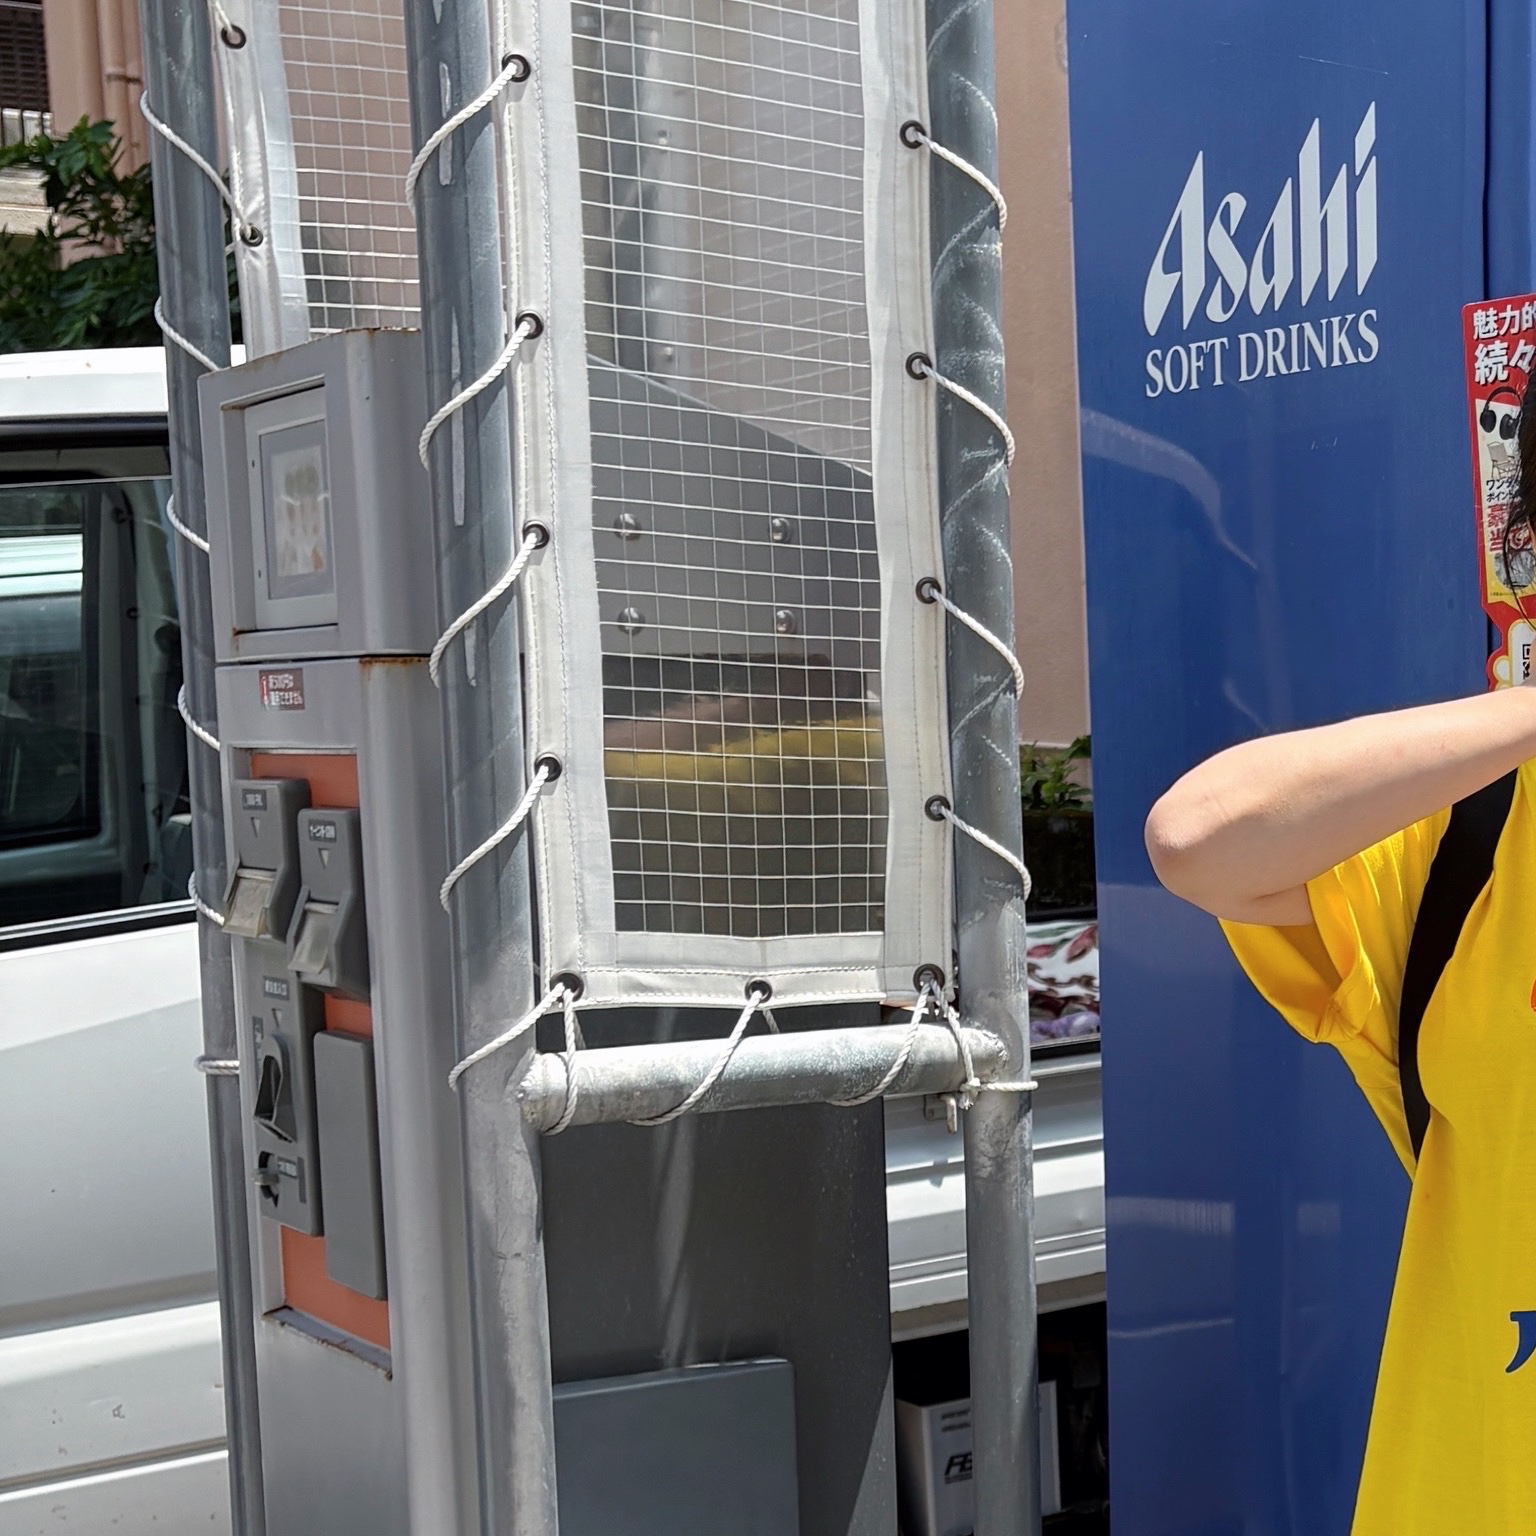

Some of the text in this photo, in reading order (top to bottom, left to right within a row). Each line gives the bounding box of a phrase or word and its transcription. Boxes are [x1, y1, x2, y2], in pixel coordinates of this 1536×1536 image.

[1144, 101, 1378, 336] Asahi
[1146, 309, 1379, 398] SOFT DRINKS
